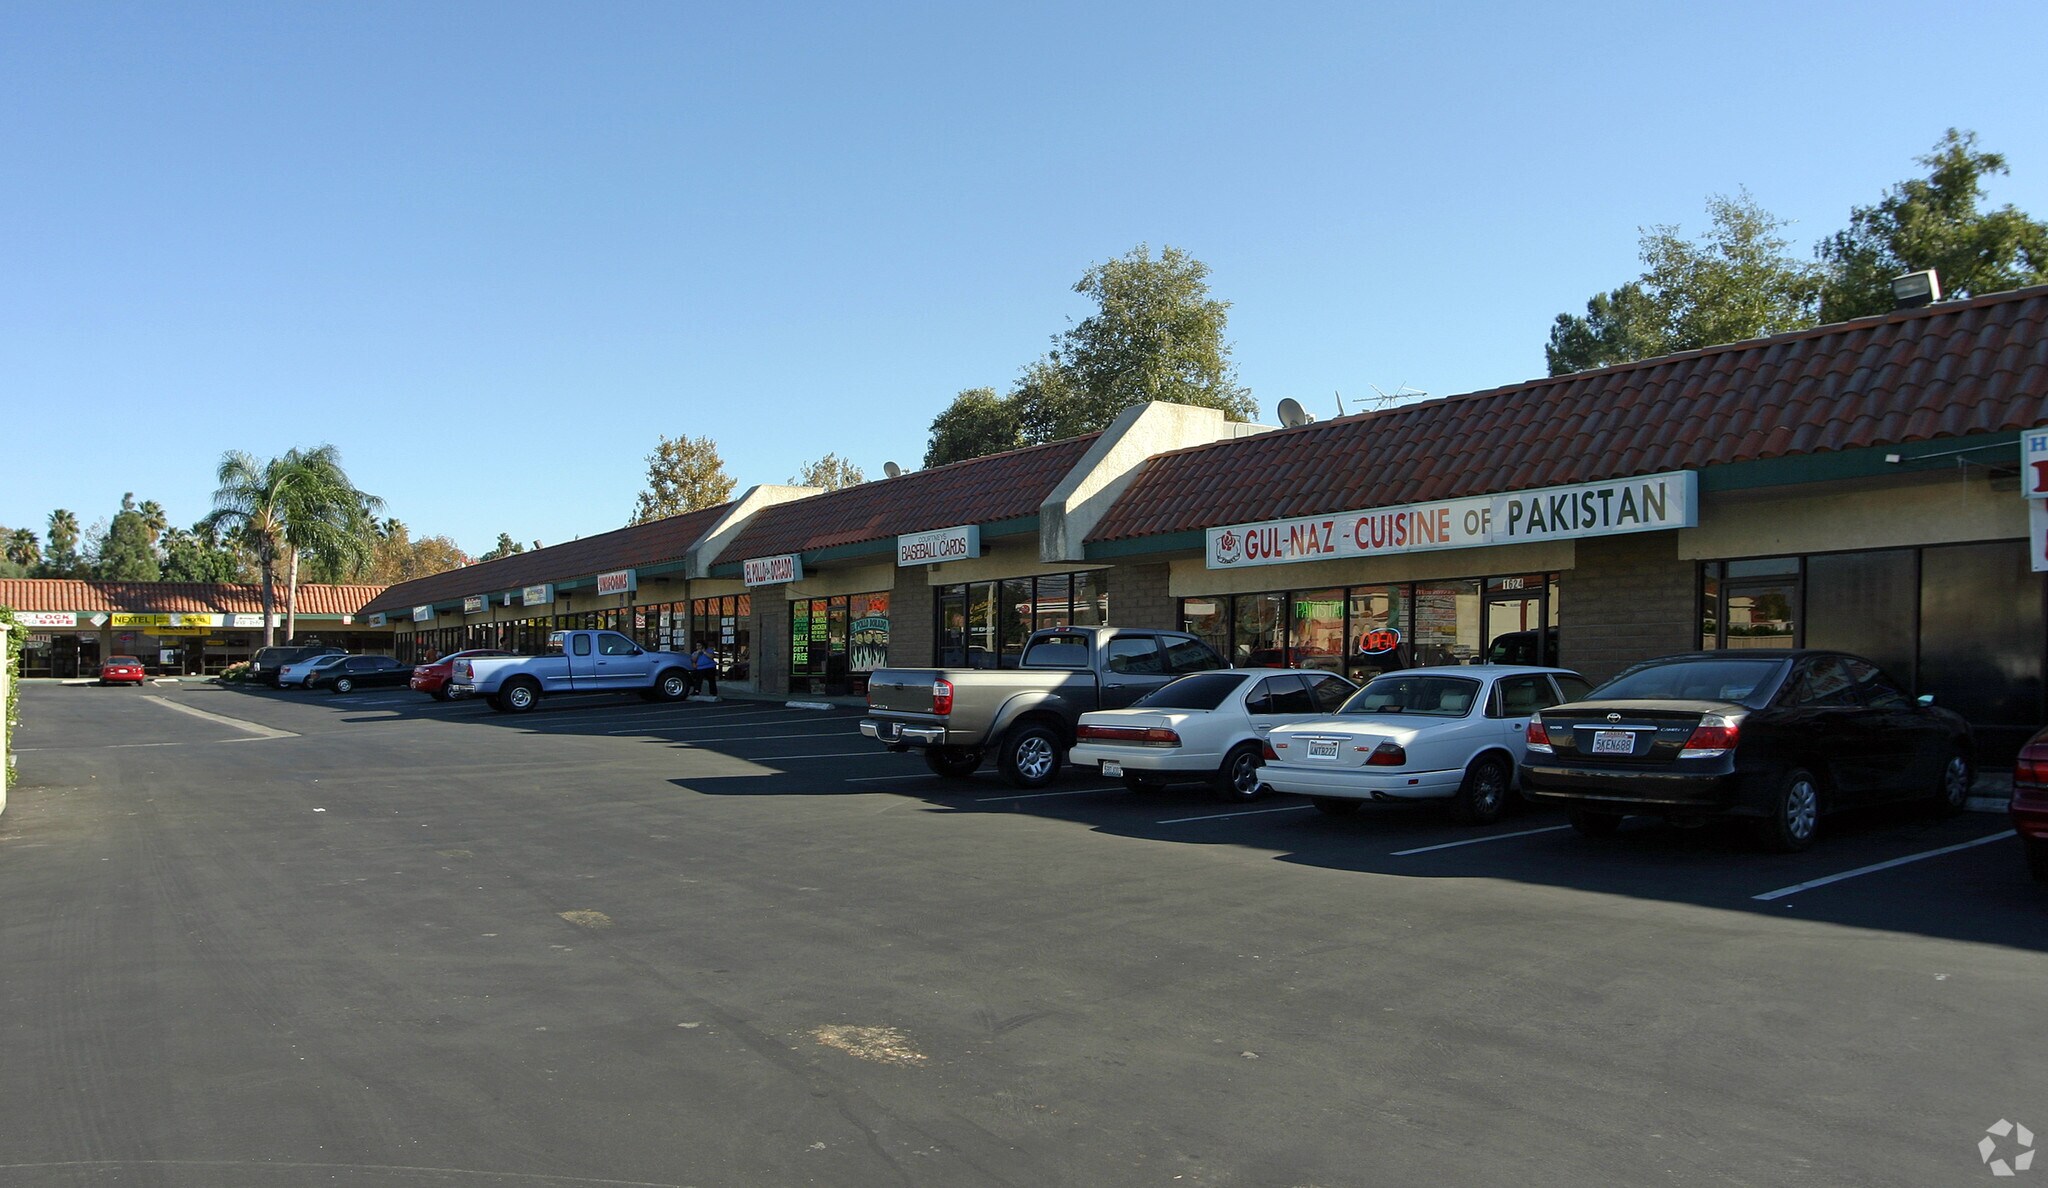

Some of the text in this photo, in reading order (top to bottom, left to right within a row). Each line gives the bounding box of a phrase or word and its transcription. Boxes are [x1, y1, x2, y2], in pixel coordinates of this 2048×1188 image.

[1464, 508, 1491, 535] OF
[1508, 482, 1666, 535] PAKISTAN
[901, 537, 966, 561] BASEBALL CARDS
[1504, 579, 1523, 589] 1624
[114, 616, 150, 624] NEXTEL
[1361, 632, 1397, 650] OPEN
[793, 653, 808, 661] FREE
[1596, 739, 1631, 751] 5KEN688
